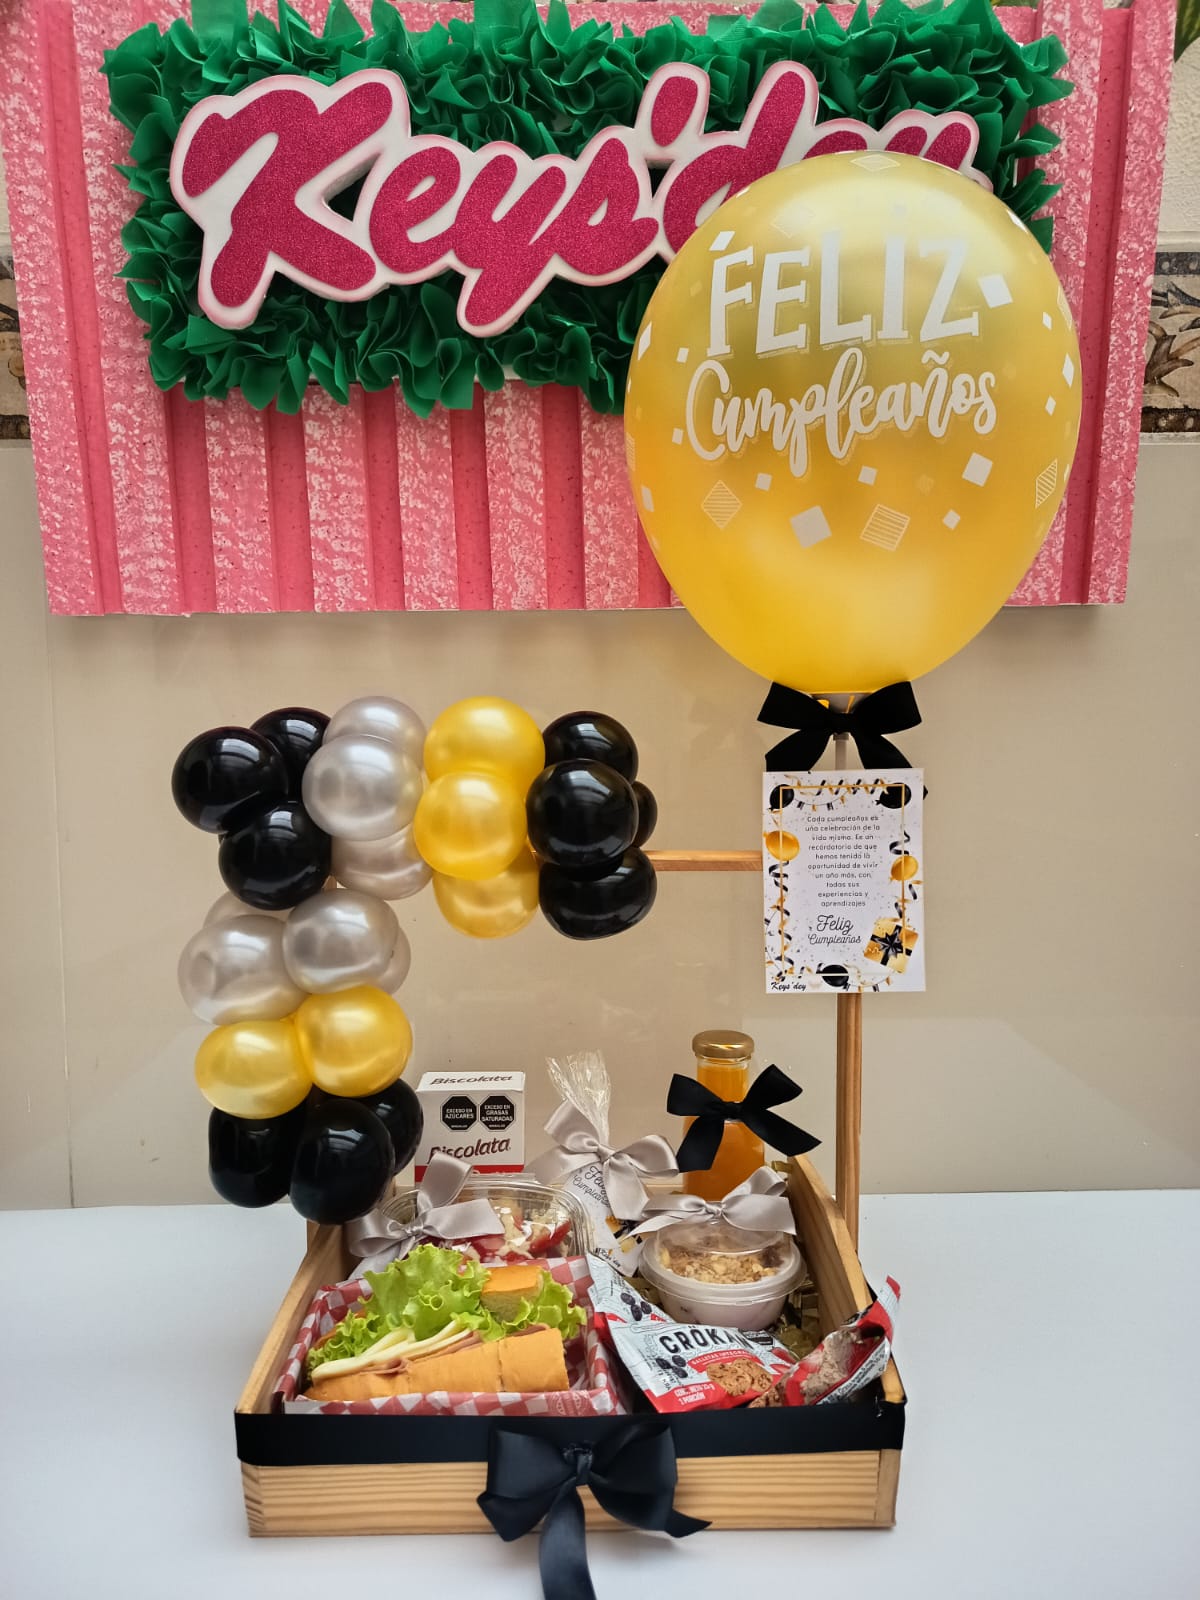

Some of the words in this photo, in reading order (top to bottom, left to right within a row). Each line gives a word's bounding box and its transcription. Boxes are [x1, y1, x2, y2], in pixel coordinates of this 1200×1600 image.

[182, 70, 972, 327] Keys'd
[706, 229, 980, 358] FELIZ
[686, 347, 998, 477] Cumpleaños
[807, 862, 850, 870] oportunidad
[820, 900, 866, 908] aprendizajes
[816, 914, 854, 936] Feliz
[807, 934, 862, 947] Cumpleaños
[770, 981, 807, 992] Keys'dey
[430, 1075, 513, 1086] Biscolata
